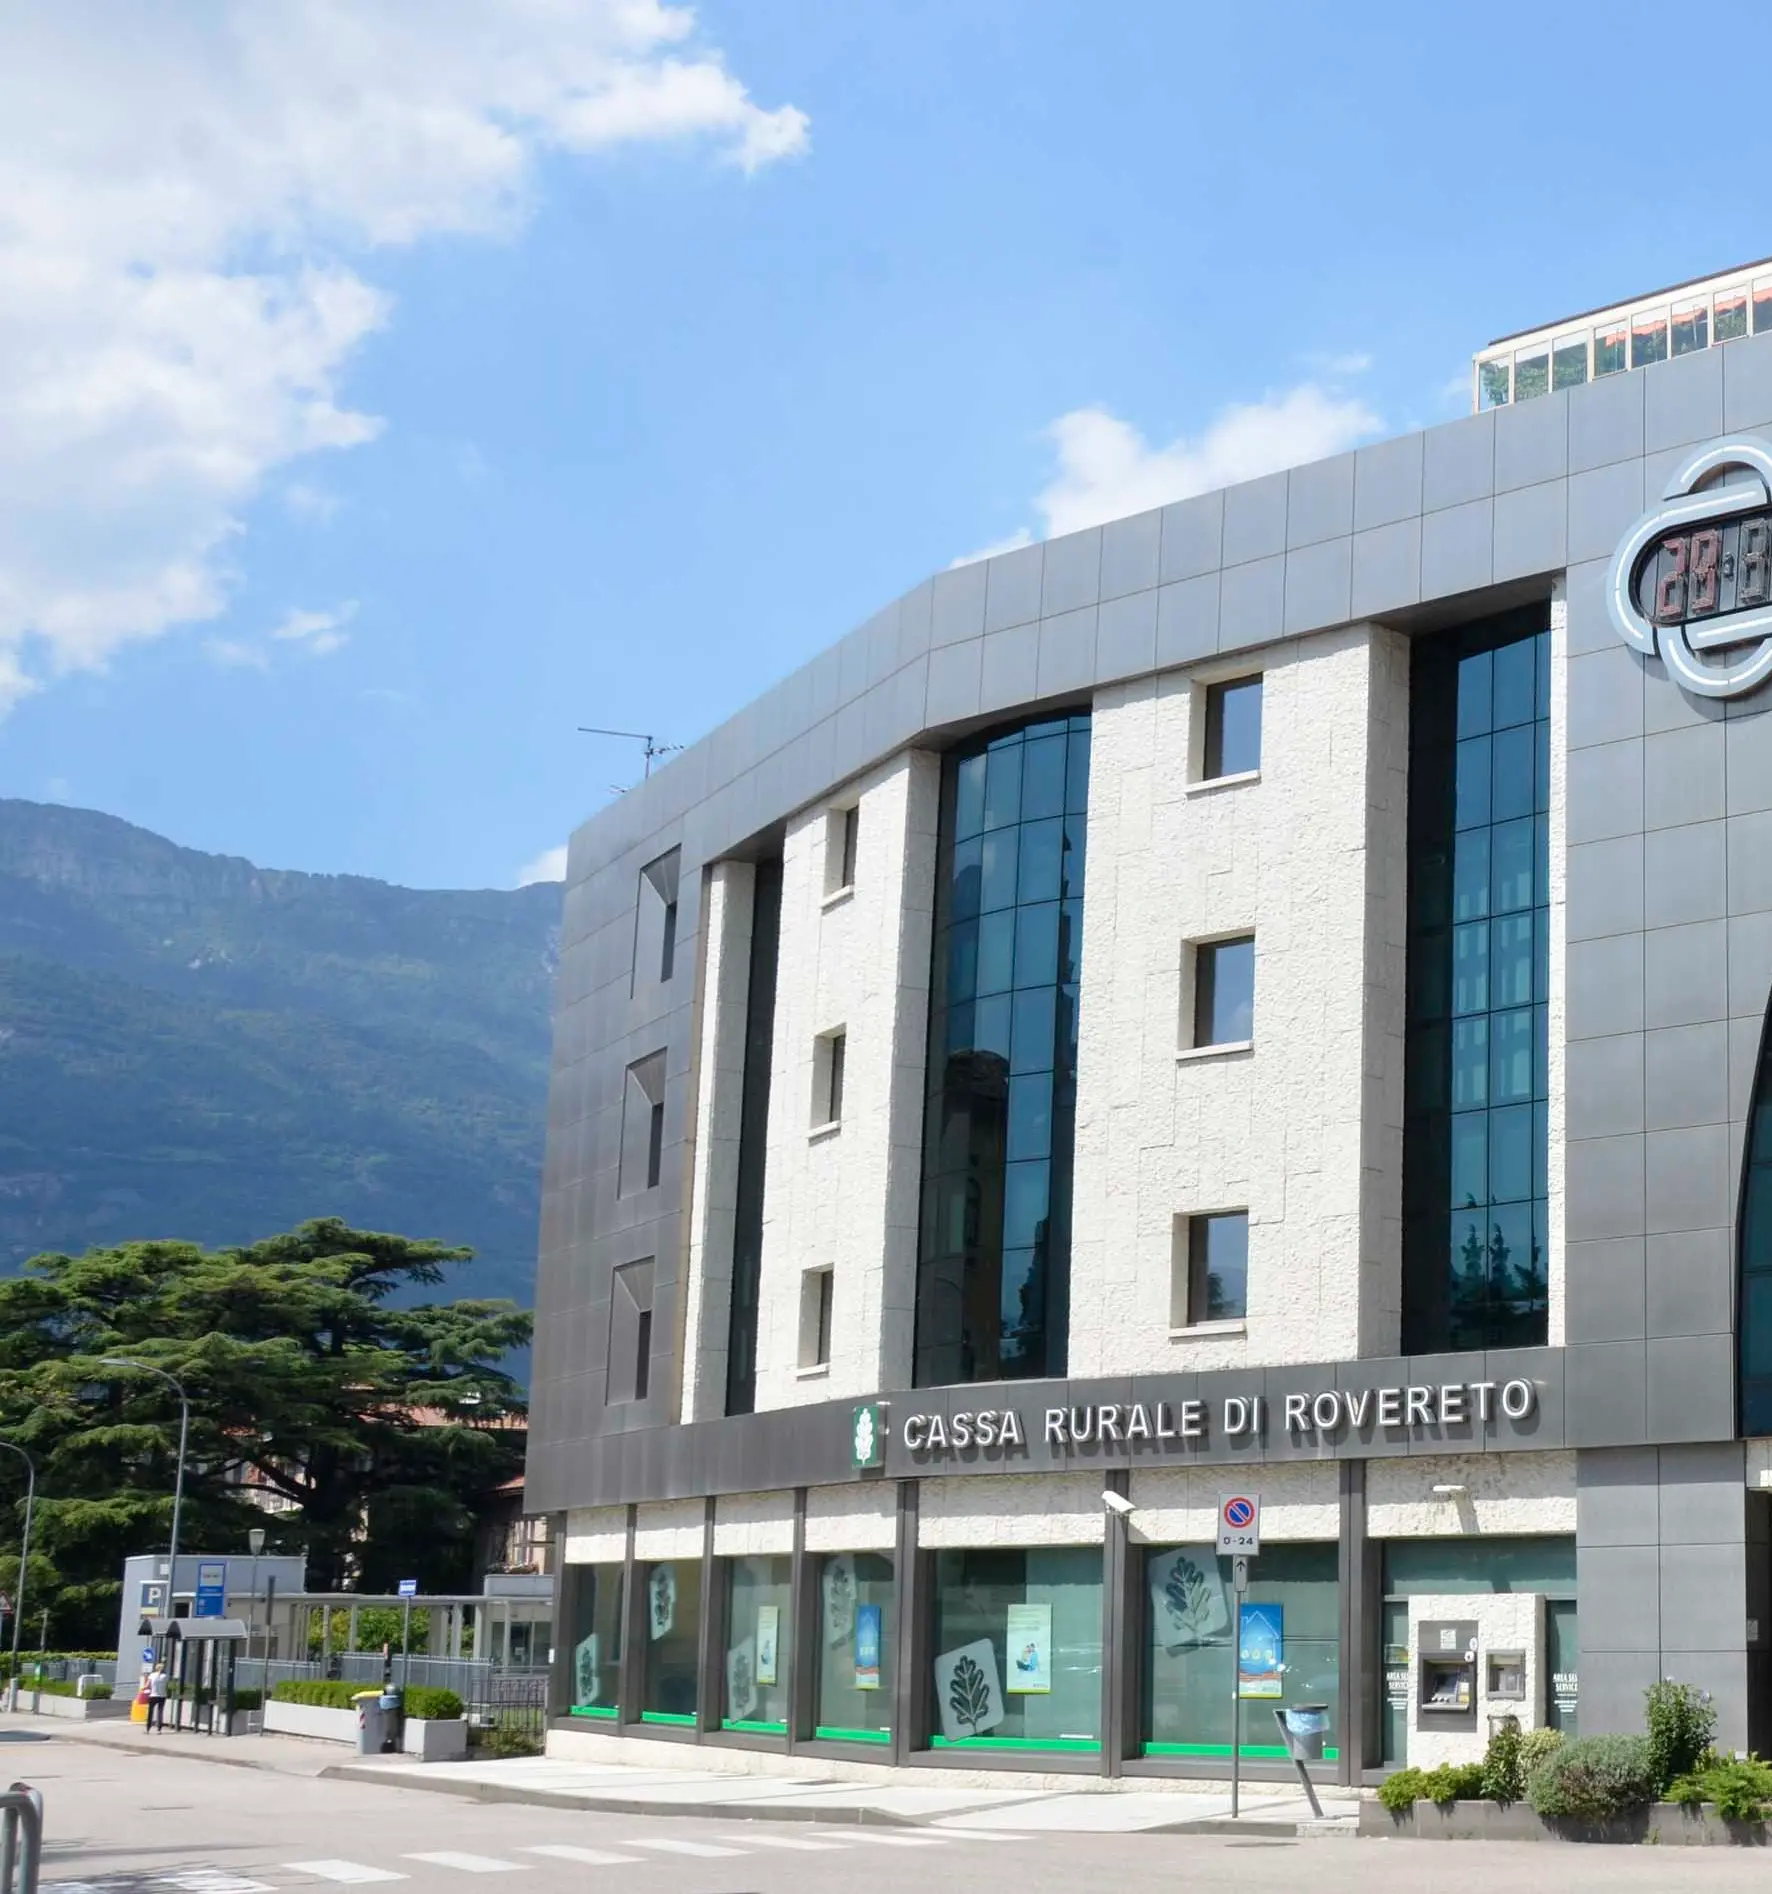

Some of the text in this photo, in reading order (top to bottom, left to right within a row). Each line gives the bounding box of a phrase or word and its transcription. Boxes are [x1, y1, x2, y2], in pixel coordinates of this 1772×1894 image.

[904, 1378, 1535, 1448] CASSA RURALE DI ROVERETO
[147, 1586, 162, 1605] P
